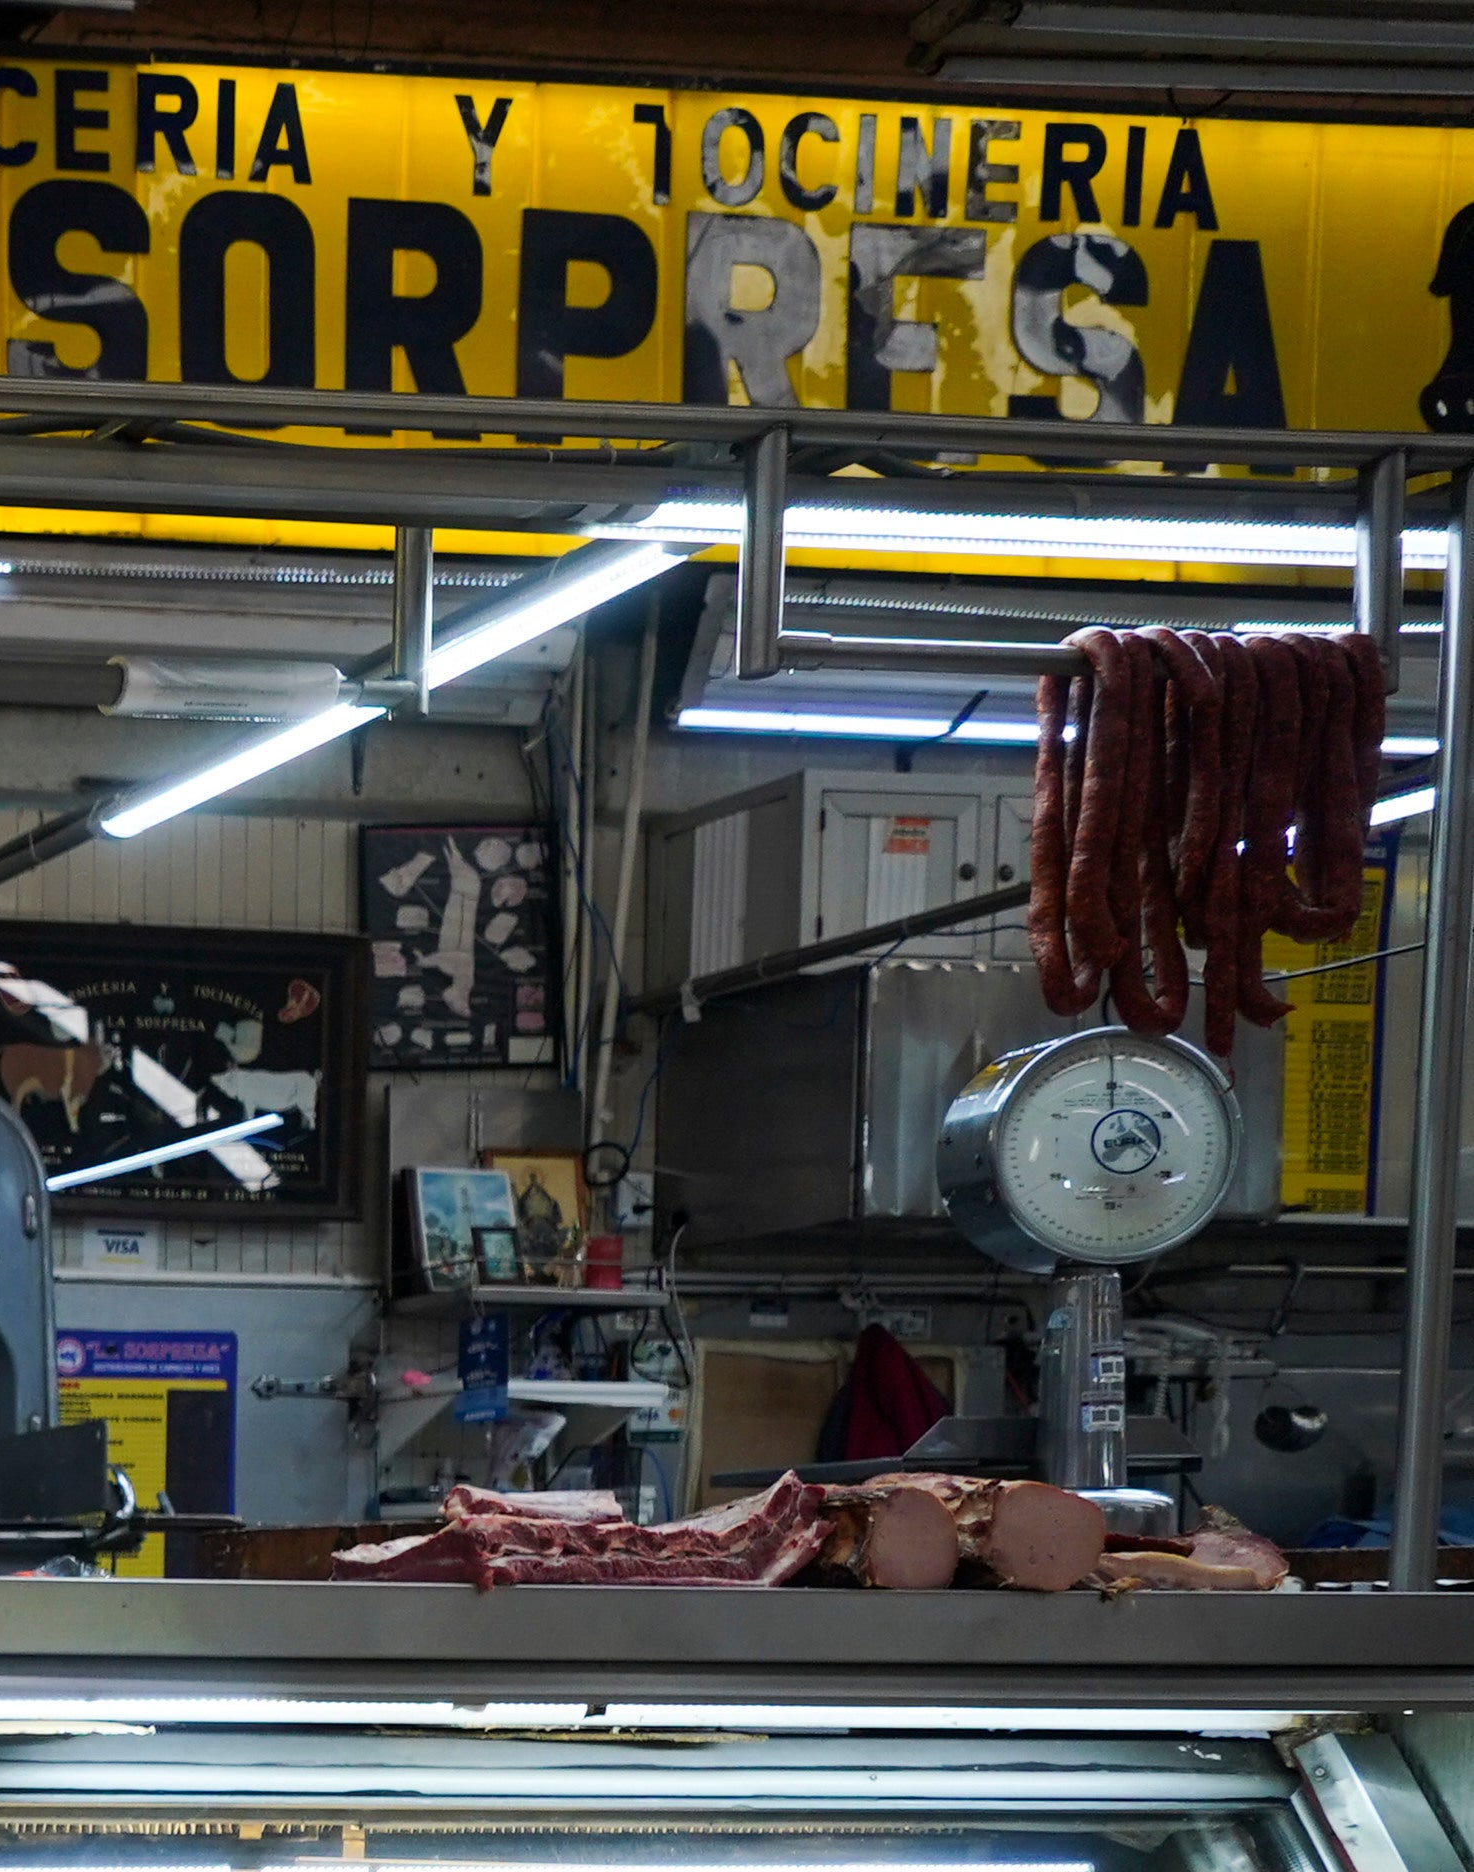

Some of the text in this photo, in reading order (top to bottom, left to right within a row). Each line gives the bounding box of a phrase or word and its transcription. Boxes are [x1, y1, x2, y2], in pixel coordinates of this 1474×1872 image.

[455, 95, 514, 197] Y
[635, 103, 1219, 233] TOCINERIA
[7, 178, 1297, 475] SORPRESA
[136, 1016, 207, 1032] SORPRESA
[104, 1239, 140, 1255] VISA
